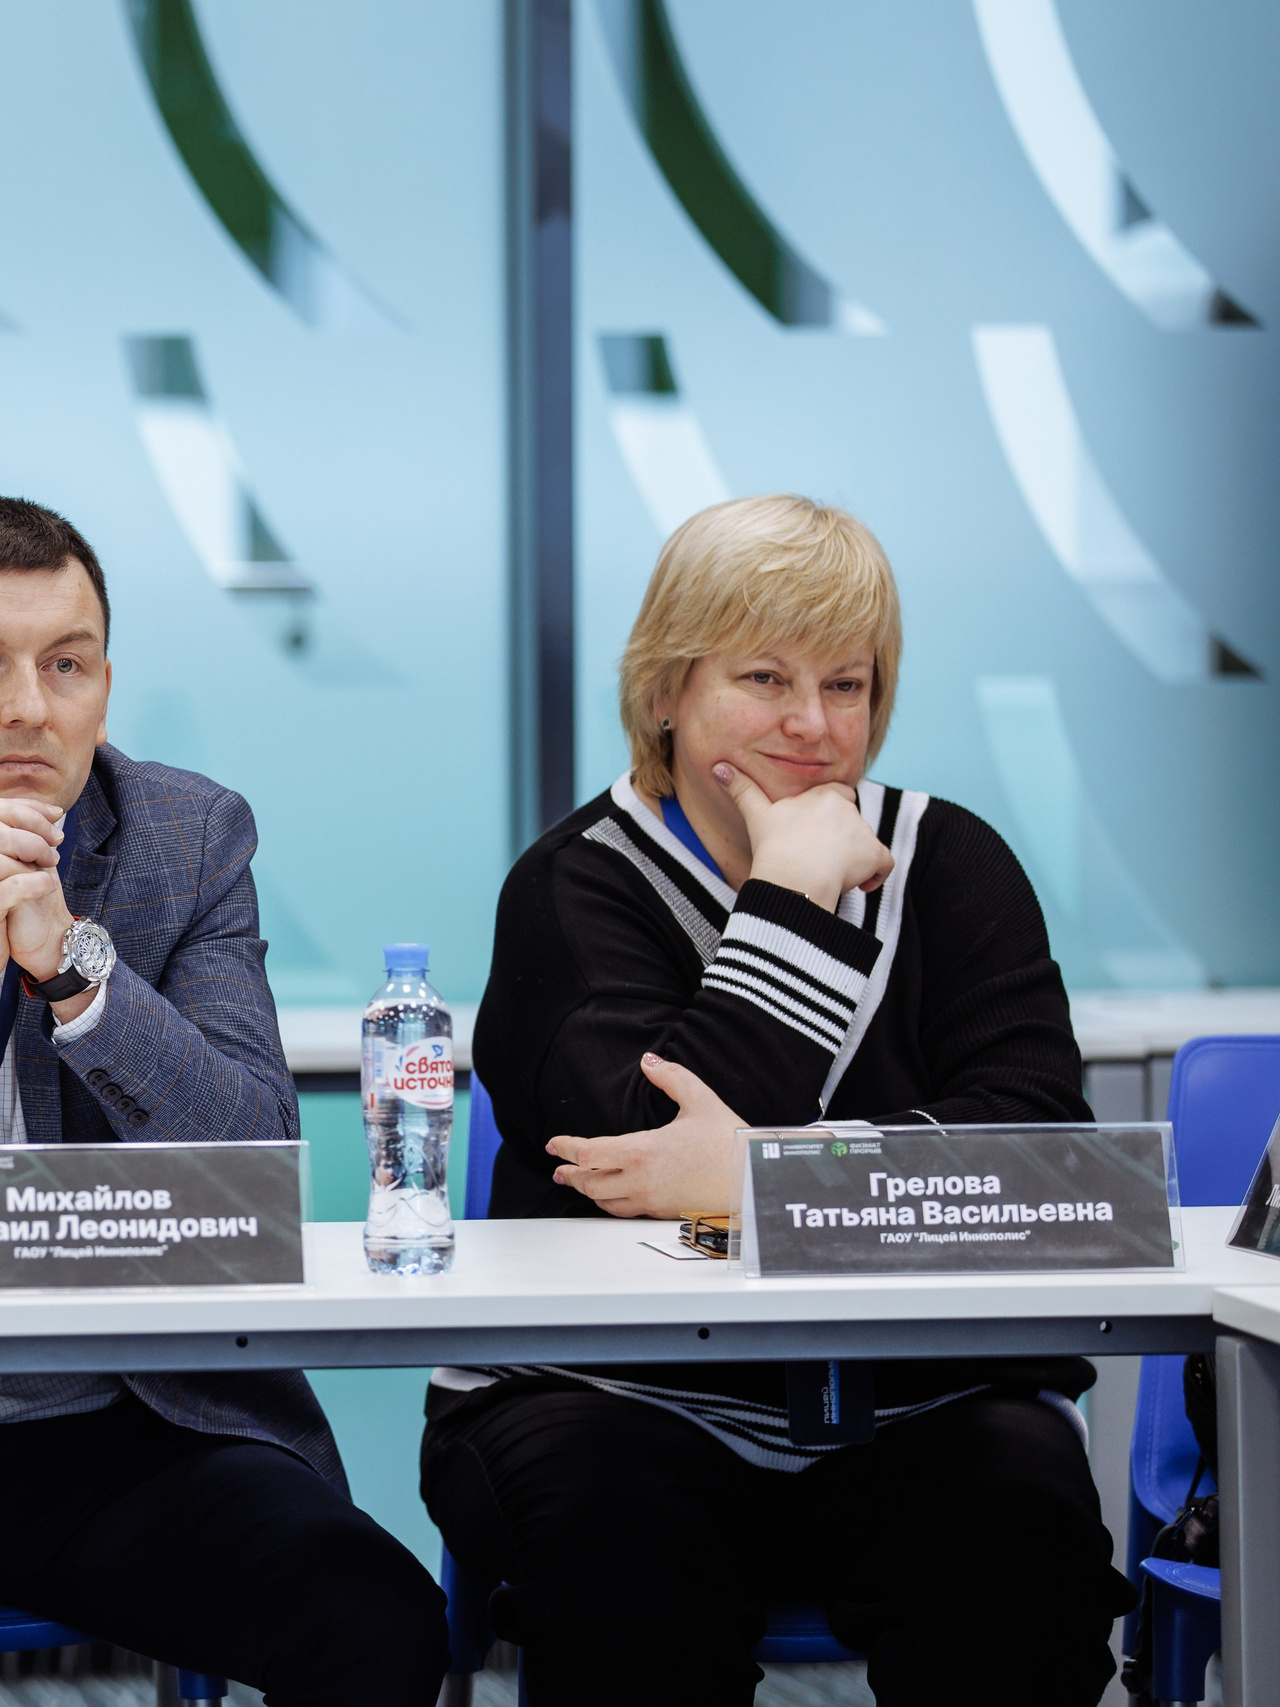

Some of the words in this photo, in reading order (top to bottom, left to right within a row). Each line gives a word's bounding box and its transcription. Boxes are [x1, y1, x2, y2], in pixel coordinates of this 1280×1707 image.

[405, 1056, 454, 1074] свято
[393, 1076, 454, 1090] источн
[6, 1184, 172, 1212] Михайлов
[869, 1172, 1001, 1203] Грелова
[785, 1203, 916, 1228] Татьяна
[921, 1200, 1114, 1225] Васильевна
[54, 1214, 258, 1243] Леонидович
[880, 1232, 913, 1244] ГАОУ
[914, 1231, 958, 1244] "Лицей
[959, 1230, 1031, 1242] Иннополис"
[13, 1246, 47, 1259] ГАОУ
